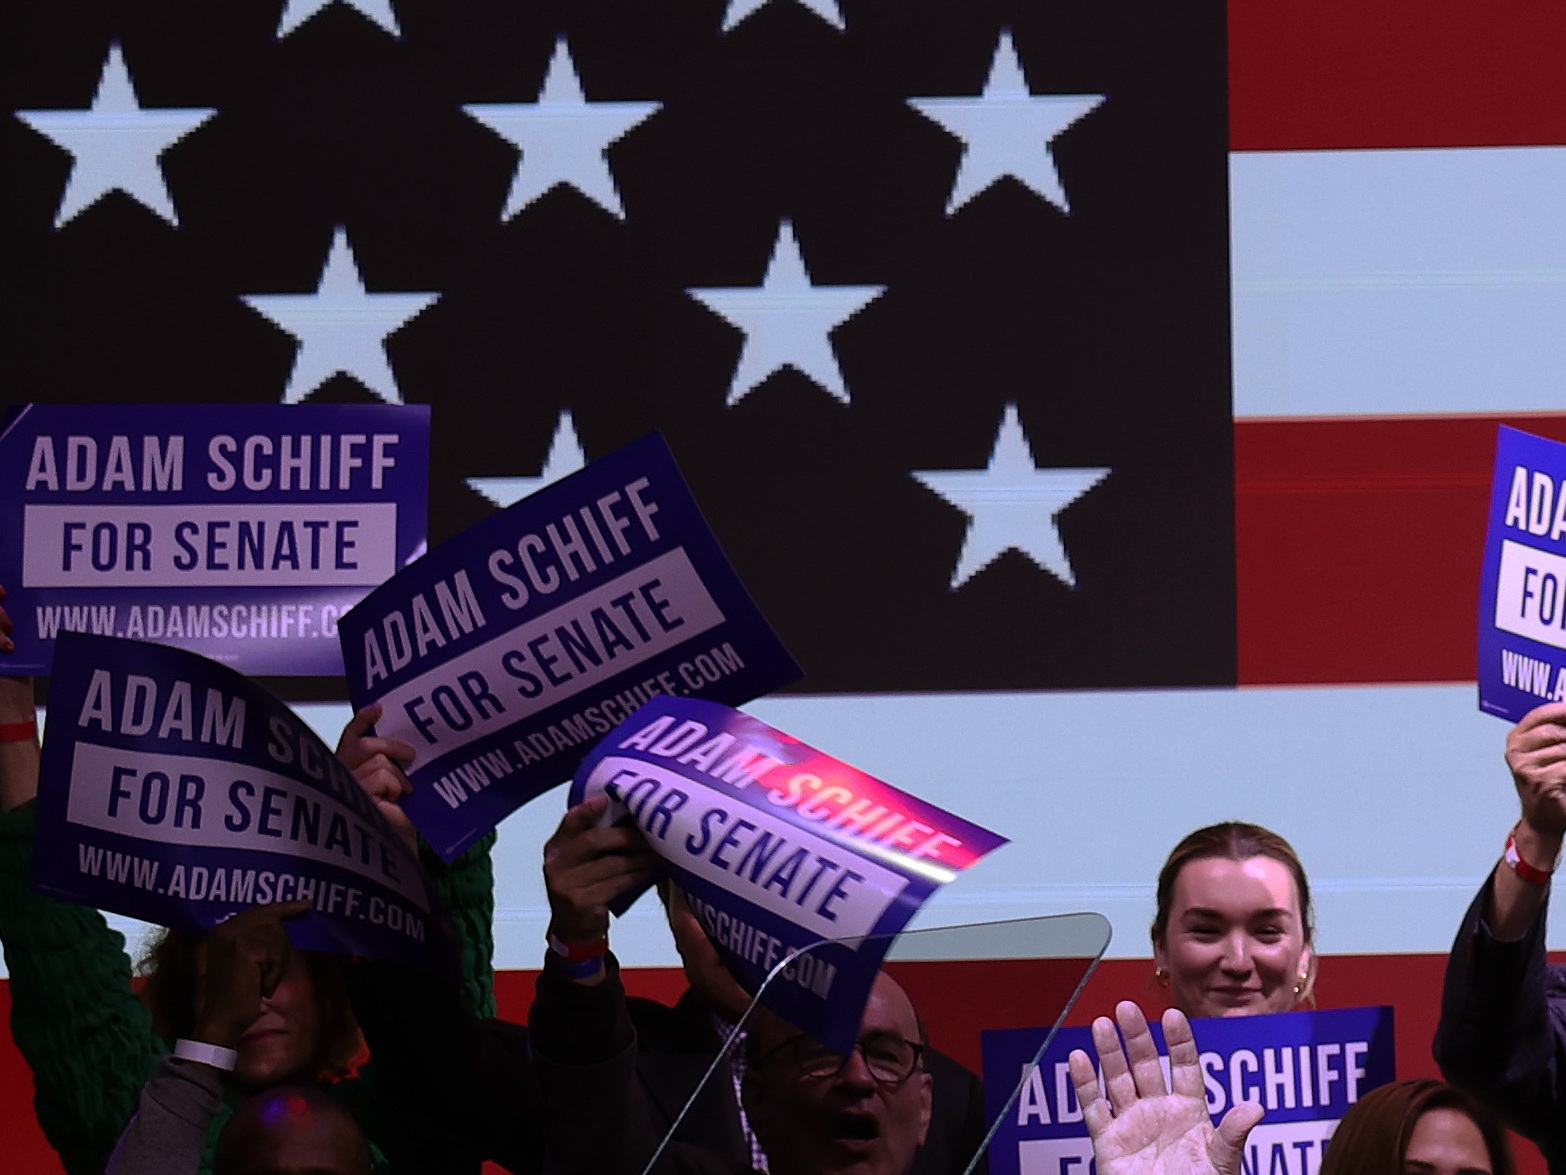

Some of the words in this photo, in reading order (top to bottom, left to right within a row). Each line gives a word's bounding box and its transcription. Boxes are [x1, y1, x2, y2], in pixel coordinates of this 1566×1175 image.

[25, 435, 184, 491] ADAM
[207, 434, 399, 491] SCHIFF
[62, 522, 152, 572] FOR
[173, 520, 359, 572] SENATE
[366, 569, 487, 690] ADAM
[488, 476, 661, 610] SCHIFF
[78, 669, 247, 750] ADAM
[404, 671, 506, 745] FOR
[502, 579, 685, 699] SENATE
[107, 766, 205, 830] FOR
[225, 781, 402, 883] SENATE
[618, 715, 785, 790] ADAM
[767, 773, 962, 857] SCHIFF
[78, 843, 425, 943] WWW.ADAMSCHIFF.COM
[685, 808, 866, 922] SENATE
[1201, 1041, 1370, 1116] SCHIFF
